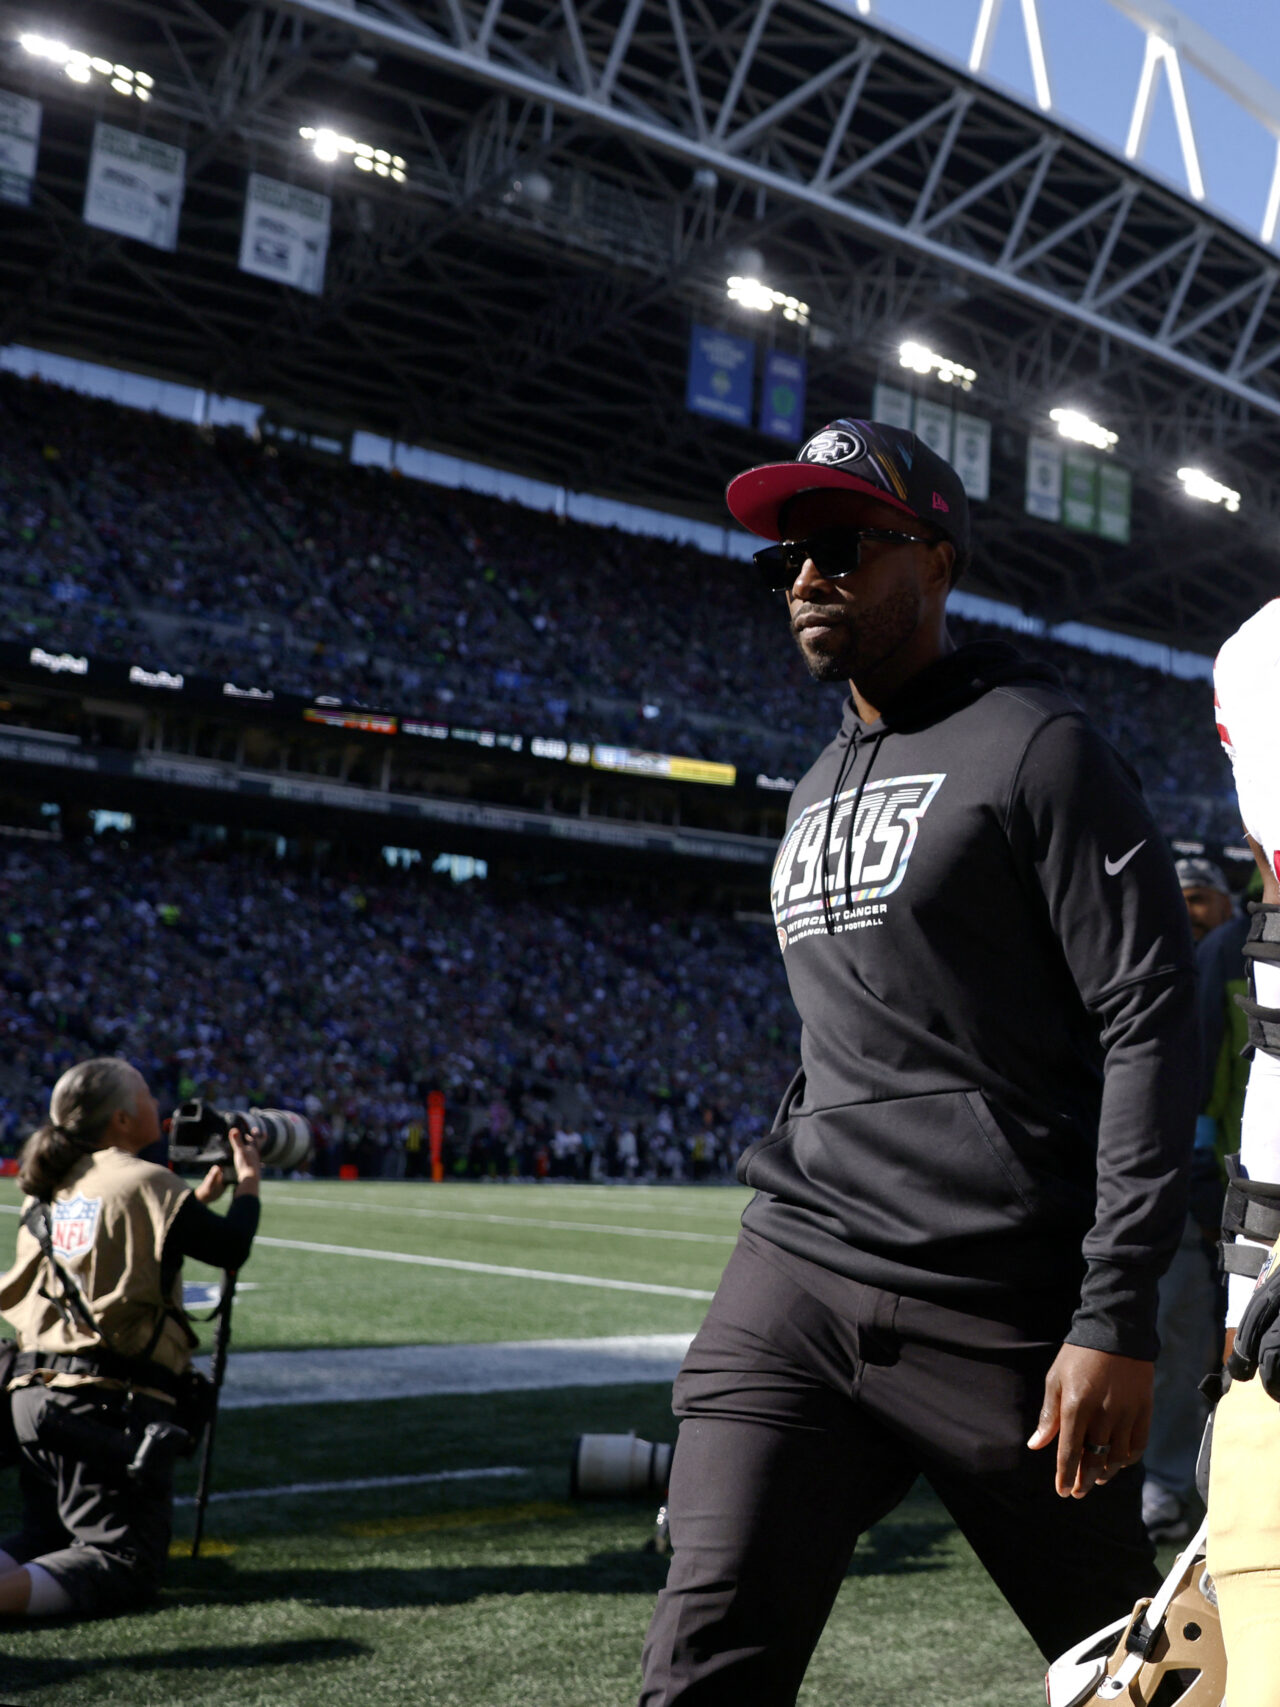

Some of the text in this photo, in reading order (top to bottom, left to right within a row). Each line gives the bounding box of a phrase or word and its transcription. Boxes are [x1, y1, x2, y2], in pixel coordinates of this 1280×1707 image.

[773, 788, 924, 907] 49ERS
[787, 904, 888, 933] INTERCET CANCER
[845, 918, 884, 931] FOOTBALL
[52, 1221, 87, 1250] NFL
